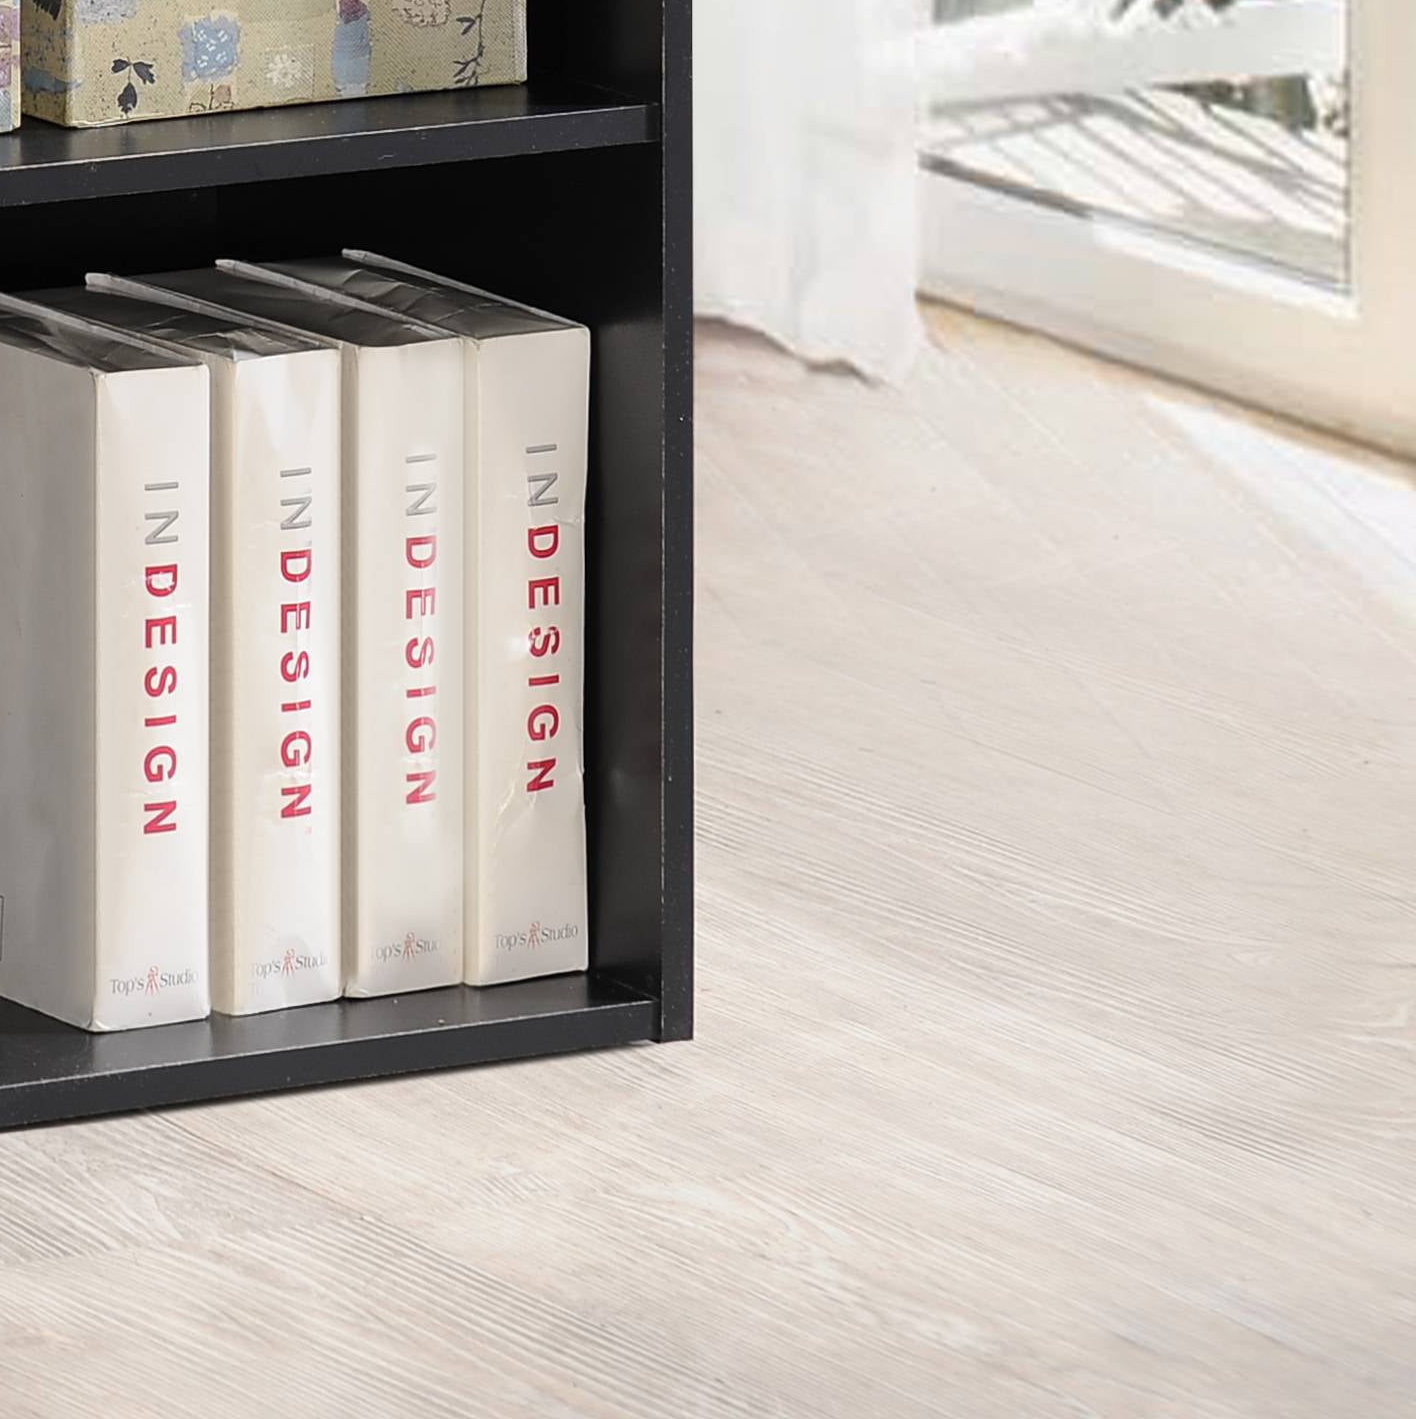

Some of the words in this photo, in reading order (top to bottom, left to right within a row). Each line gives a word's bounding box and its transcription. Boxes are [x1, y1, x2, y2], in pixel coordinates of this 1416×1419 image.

[143, 481, 180, 835] INDESIGN
[279, 467, 313, 819] INDESIGN
[405, 453, 438, 806] INDESIGN
[525, 443, 561, 793] INDESIGN
[109, 976, 145, 997] Top's
[160, 968, 200, 988] Studio
[495, 930, 526, 951] Top's
[541, 923, 578, 943] Studio
